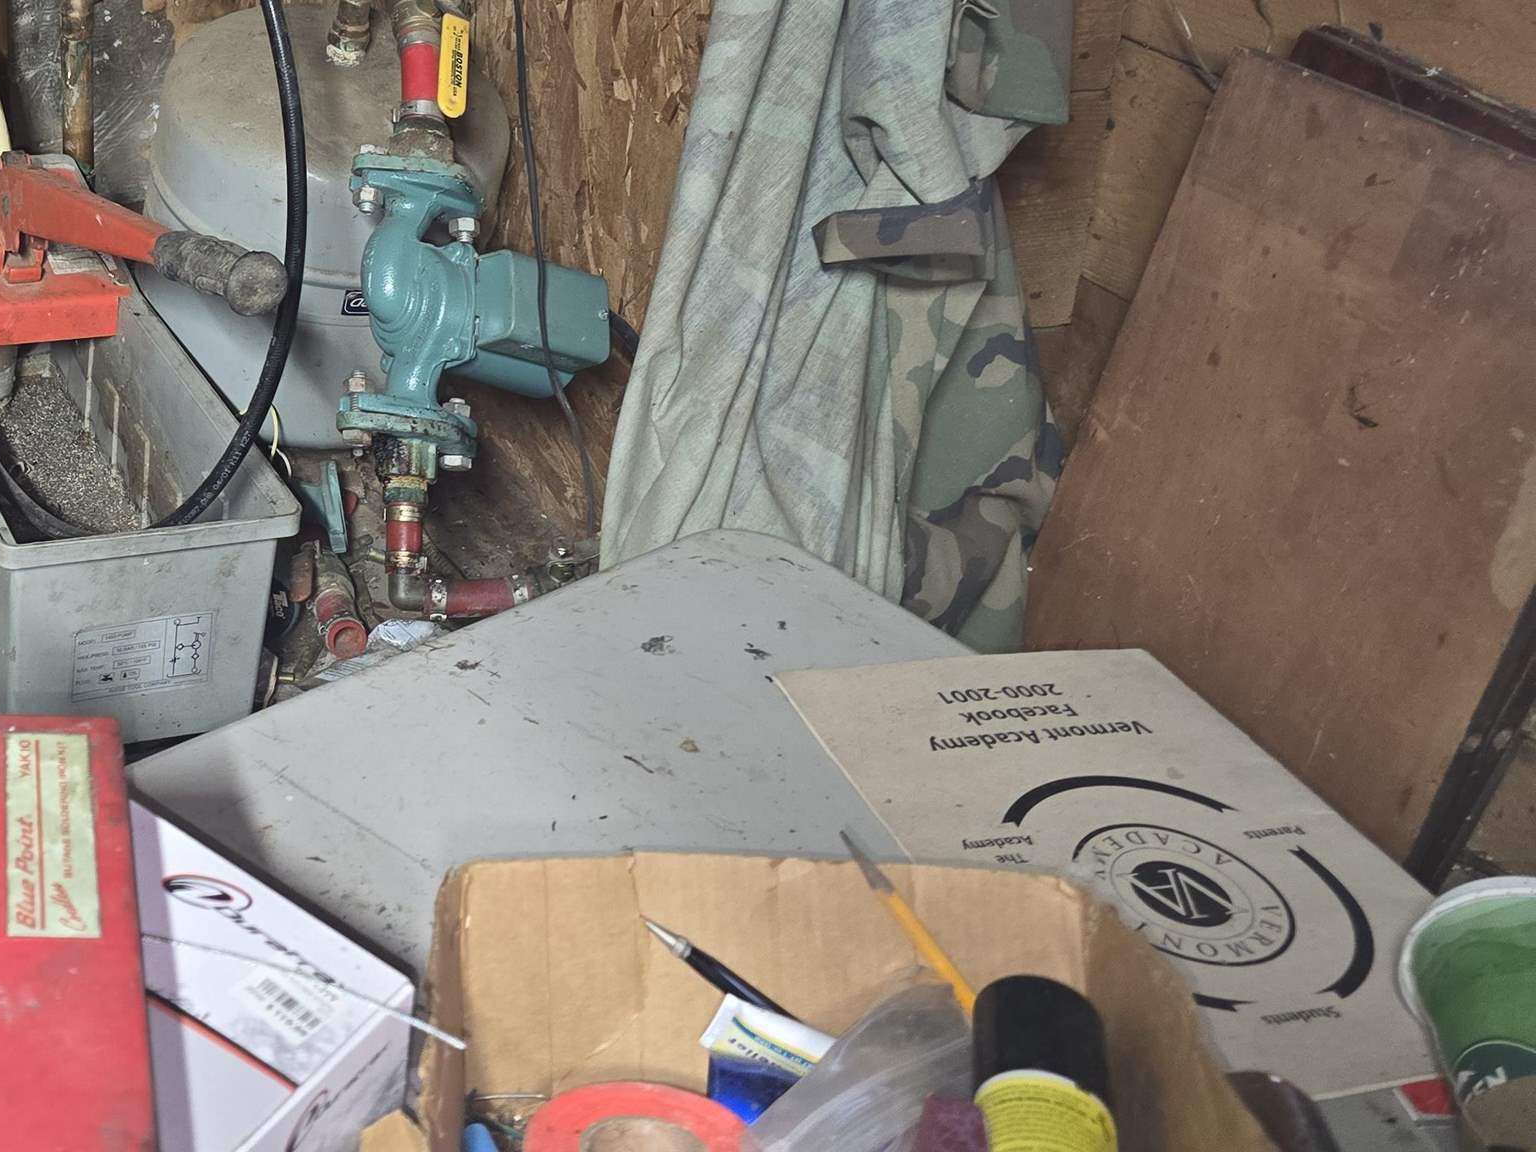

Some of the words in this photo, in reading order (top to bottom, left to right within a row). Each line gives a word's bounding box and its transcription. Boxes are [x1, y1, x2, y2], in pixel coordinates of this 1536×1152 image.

[451, 50, 466, 88] BOSTON
[937, 683, 1063, 705] 2000-2001
[959, 704, 1079, 726] Facebook
[930, 729, 1040, 751] Academy
[1042, 720, 1153, 741] Vermont
[59, 780, 71, 835] SOLDERING
[962, 835, 1034, 851] Academy
[1244, 824, 1306, 840] Parents
[16, 815, 35, 875] Point
[62, 837, 73, 878] BUTANE
[996, 854, 1029, 865] The
[16, 878, 36, 929] Blue
[1261, 1005, 1342, 1026] Students
